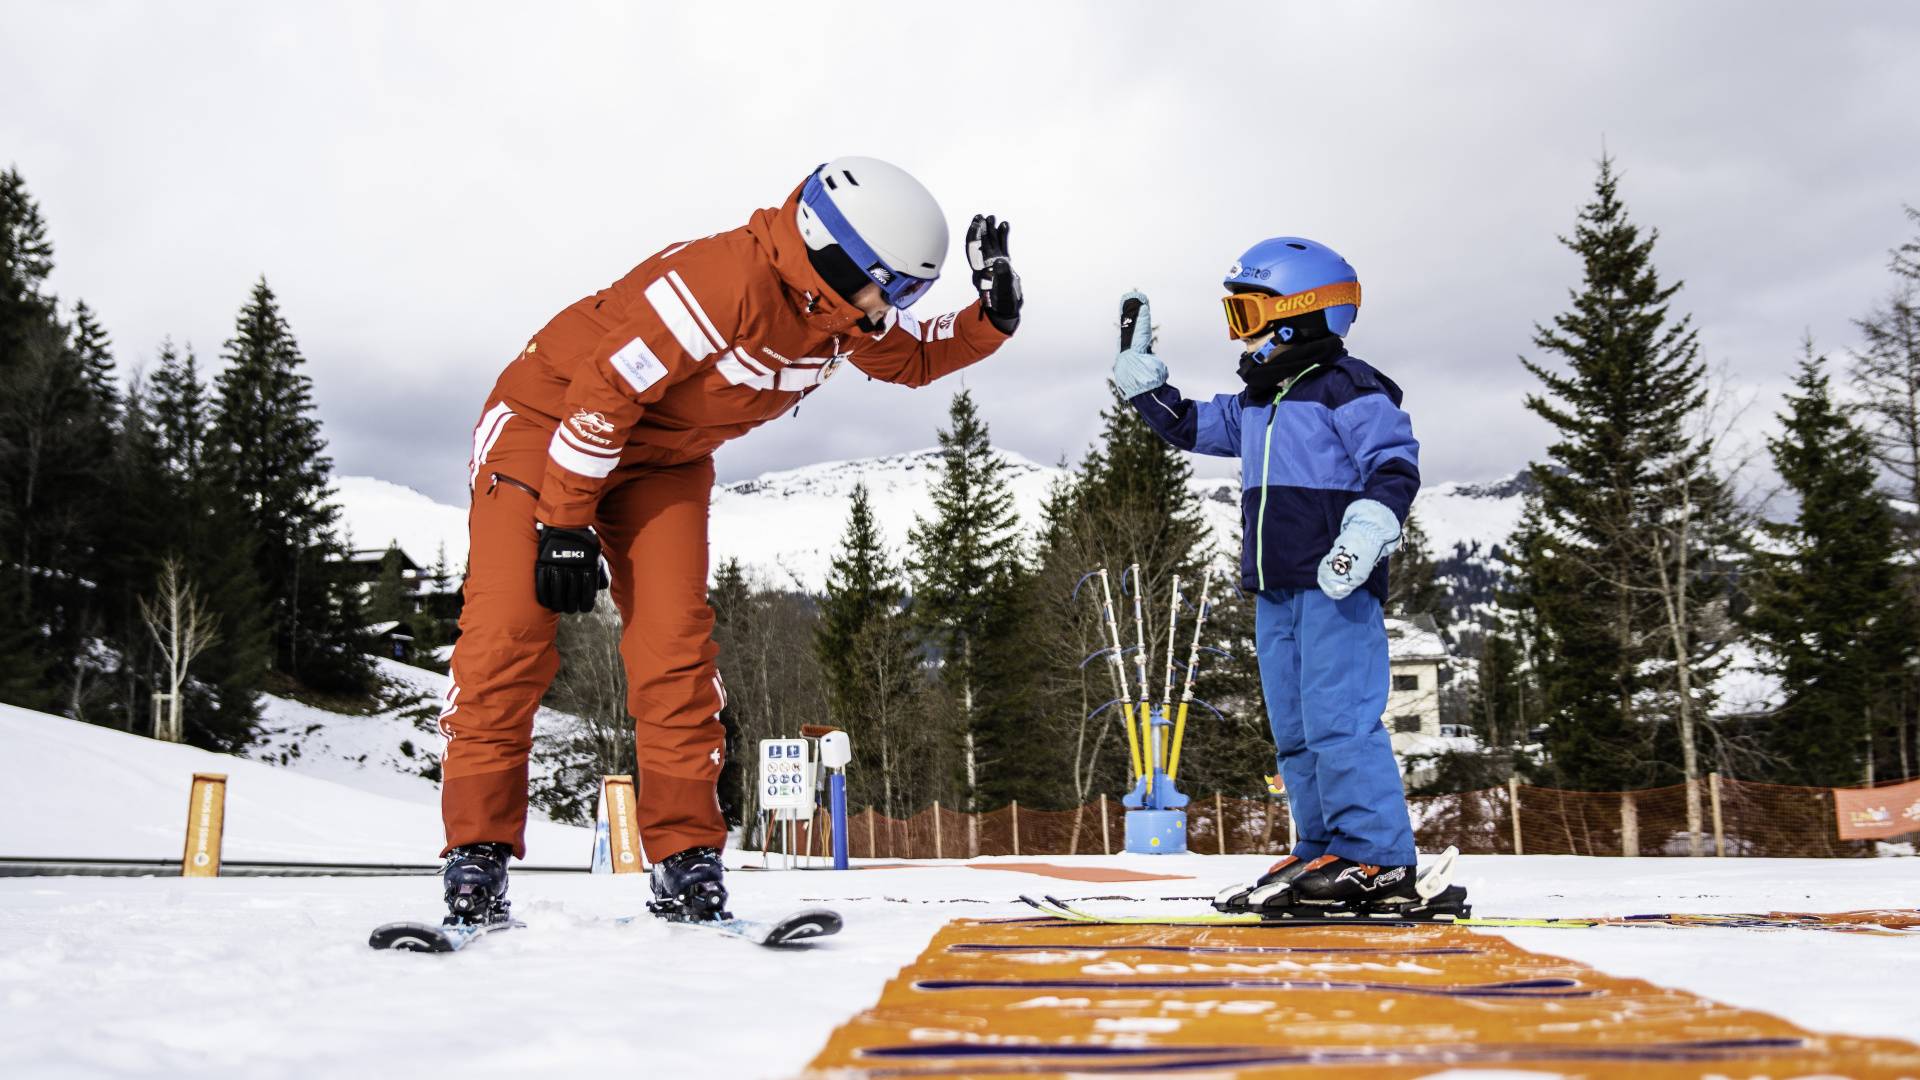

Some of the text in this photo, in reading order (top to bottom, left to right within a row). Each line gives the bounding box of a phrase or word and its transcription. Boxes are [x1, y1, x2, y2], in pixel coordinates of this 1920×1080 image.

[1241, 266, 1272, 280] GIRO
[1275, 291, 1316, 313] GIRO
[762, 346, 793, 365] GOLDTEST
[569, 417, 613, 445] GOLDTEST
[552, 550, 585, 558] LEKI
[202, 783, 213, 813] SCHOOL
[615, 786, 626, 815] SCHOOL
